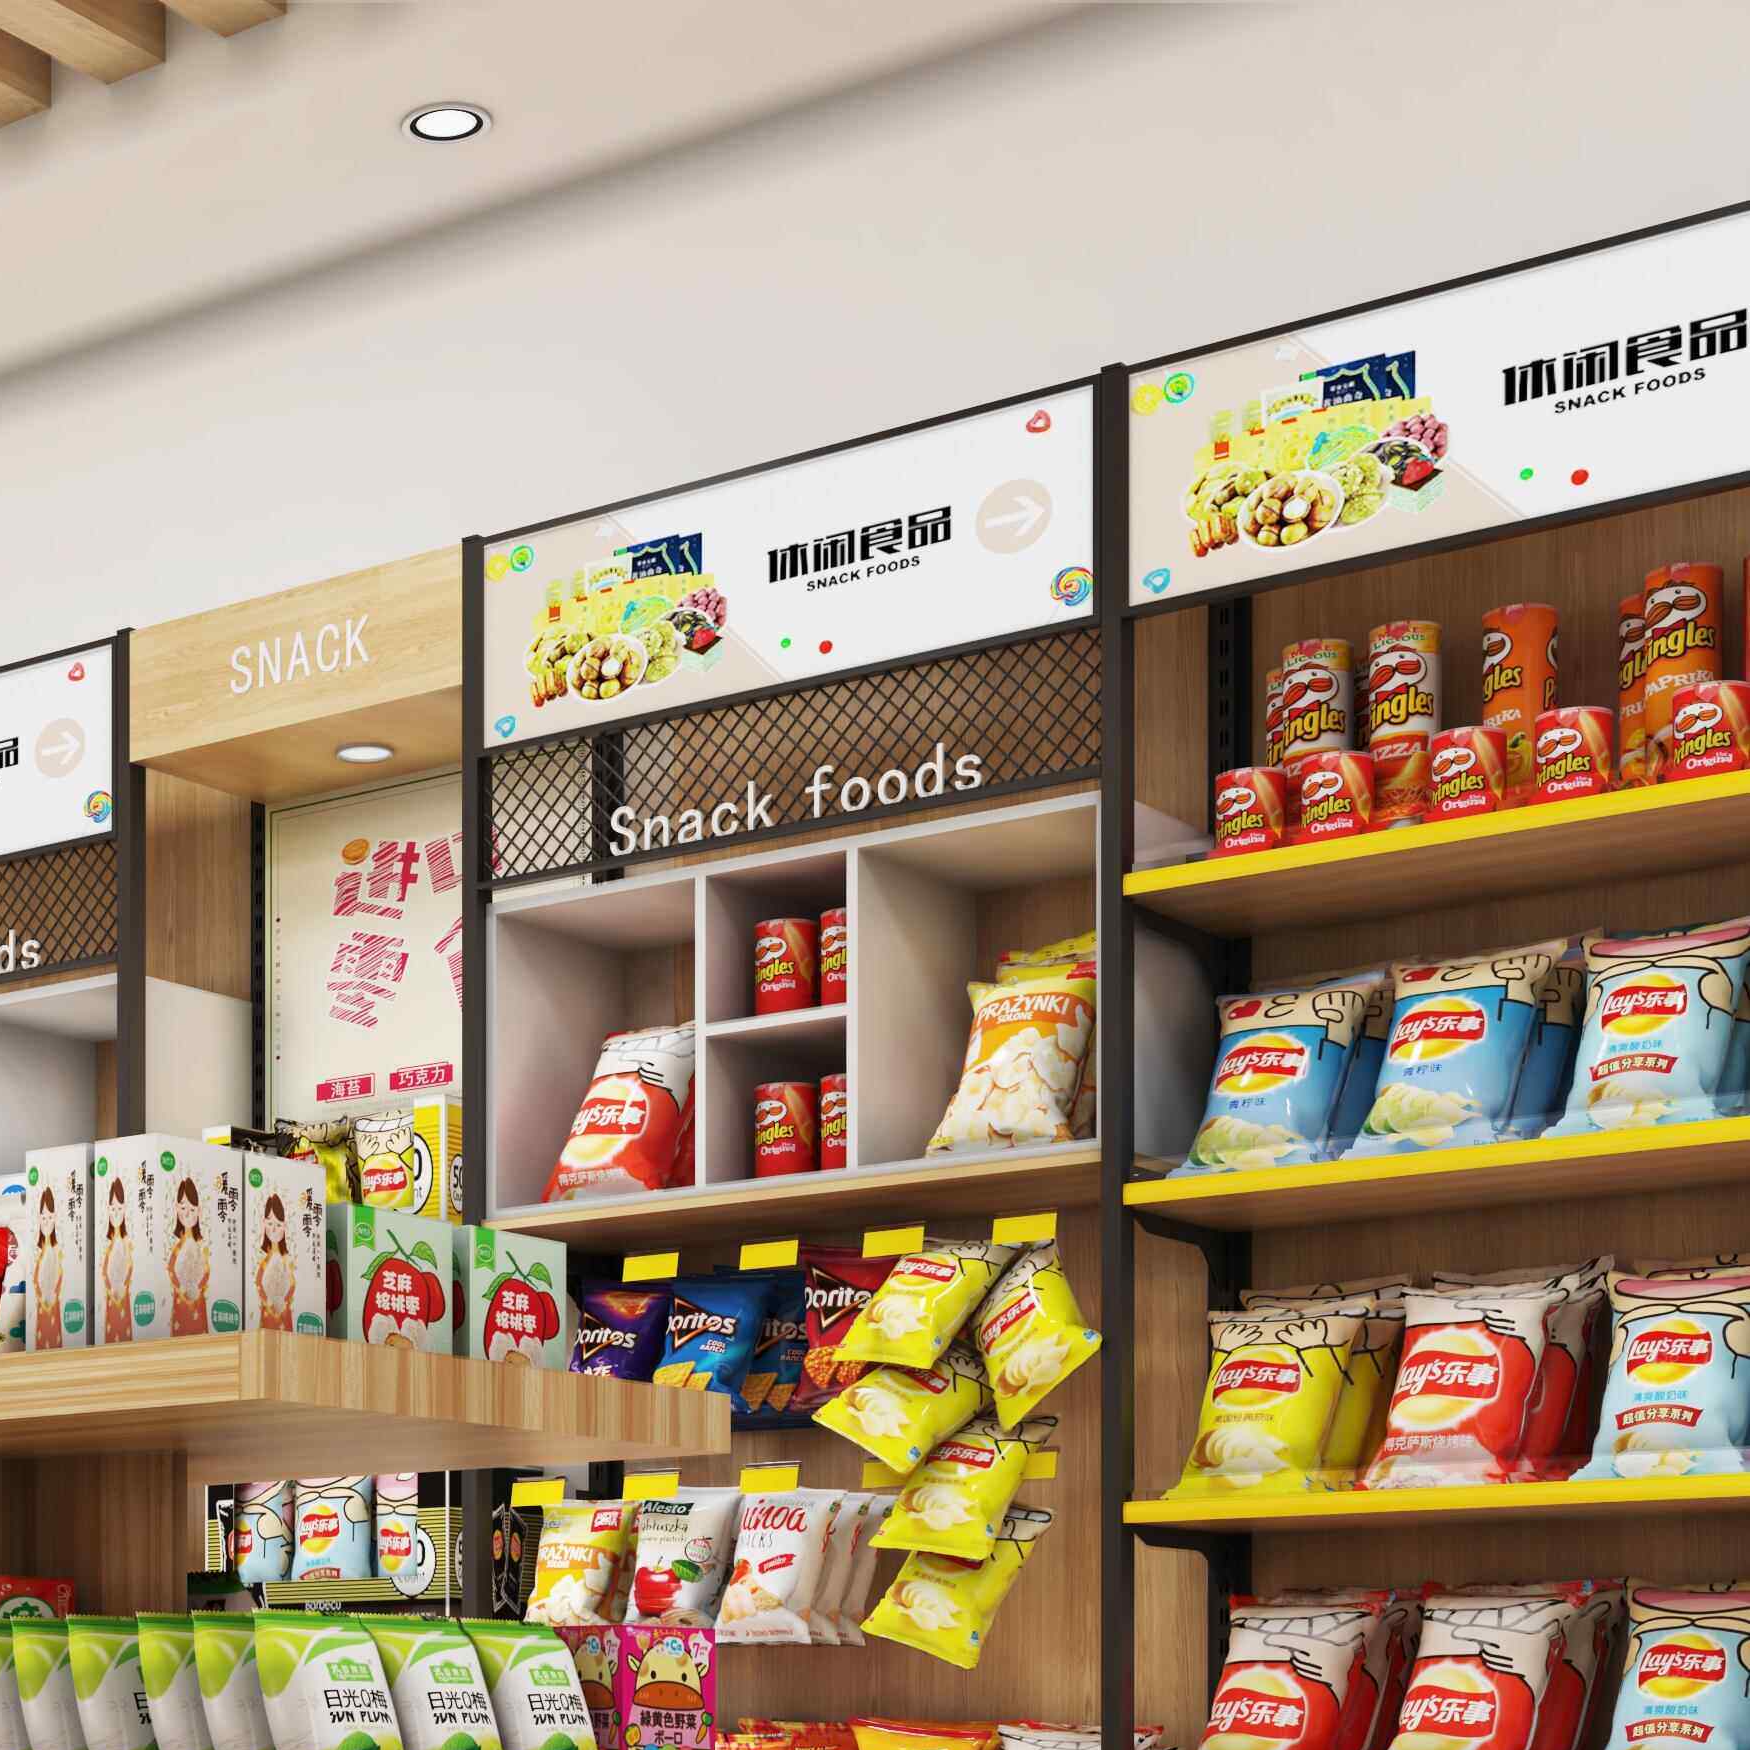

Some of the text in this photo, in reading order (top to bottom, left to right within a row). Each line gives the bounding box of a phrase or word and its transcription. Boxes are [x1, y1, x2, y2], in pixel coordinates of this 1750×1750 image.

[1502, 308, 1749, 407] 休闲食品
[1554, 366, 1707, 415] SNACK FOODS
[767, 505, 952, 584] 休闲食品
[806, 555, 921, 593] SNACK FOODS
[229, 614, 372, 695] SNACK
[1646, 620, 1716, 668] ingles
[1283, 702, 1347, 747] ingles
[1370, 685, 1435, 732] ingles
[1373, 741, 1423, 762] IZZA
[609, 741, 984, 856] Snack foods
[330, 1066, 446, 1098] 海苔 巧克力
[382, 1270, 413, 1293] 芝麻
[501, 1290, 530, 1311] 芝麻
[323, 1688, 389, 1710] 日光Q梅
[427, 1690, 487, 1712] 日光Q梅
[528, 1692, 586, 1713] 日光Q梅
[329, 1711, 393, 1725] SUN PLUM
[433, 1712, 493, 1726] SUN PLUM
[532, 1713, 557, 1726] SUN
[559, 1713, 588, 1726] PLUM
